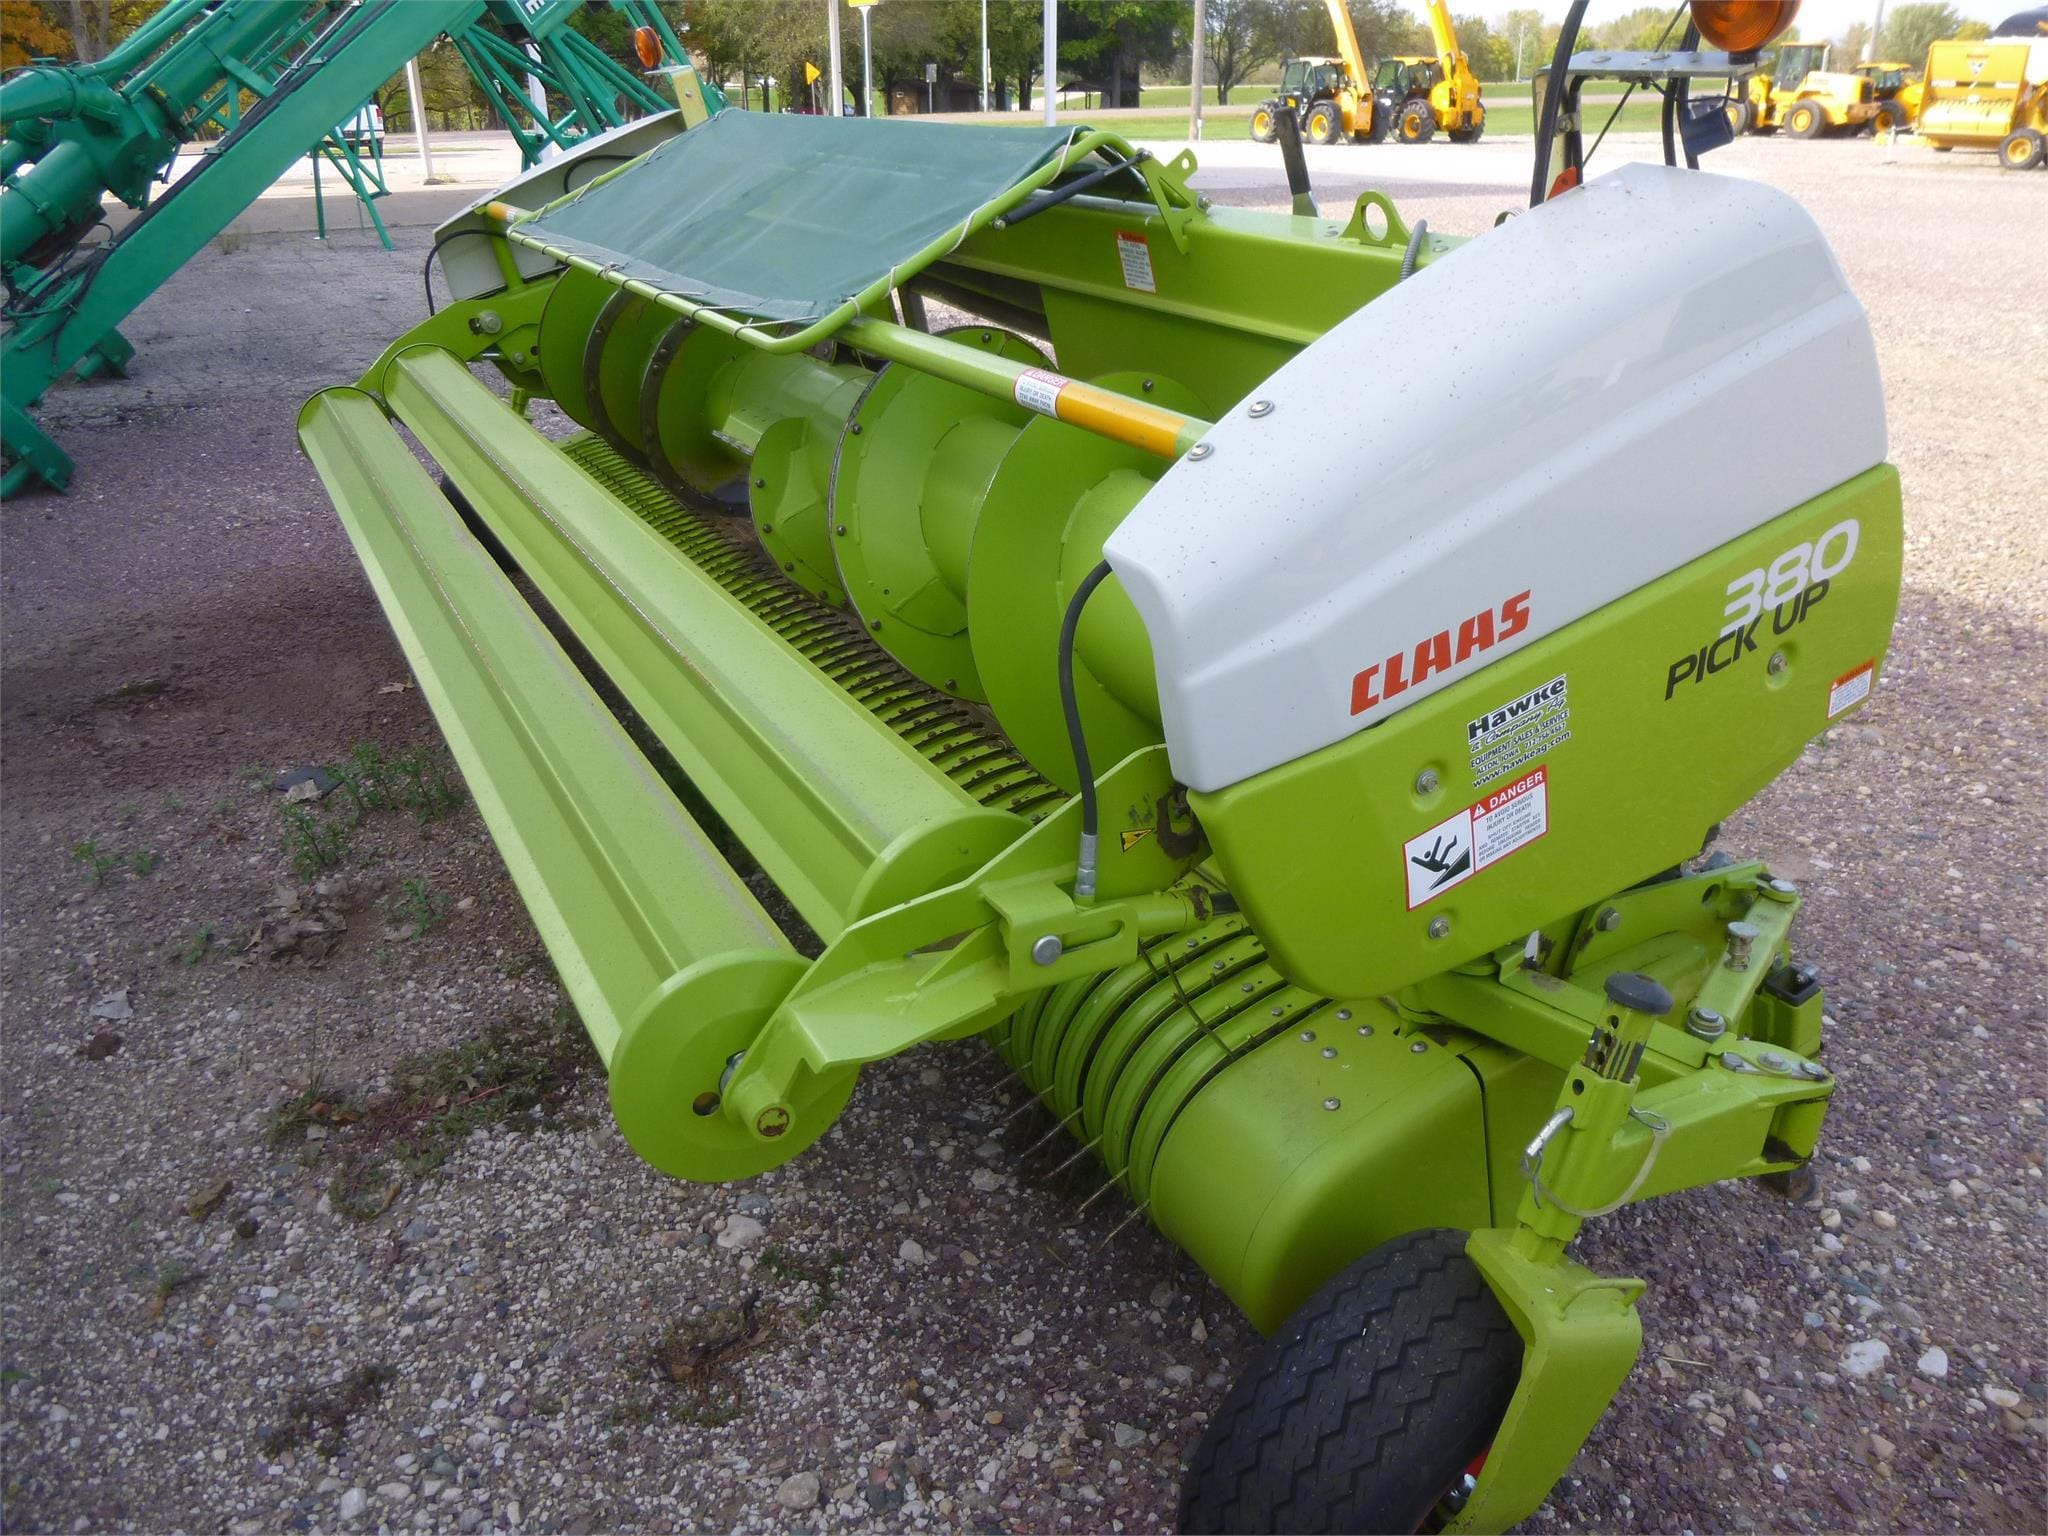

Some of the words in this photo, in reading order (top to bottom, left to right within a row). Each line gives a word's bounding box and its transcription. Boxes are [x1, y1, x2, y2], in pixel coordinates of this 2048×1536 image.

[1719, 518, 1859, 638] 380
[1350, 589, 1531, 717] CLAAS
[1664, 613, 1764, 702] PICK
[1772, 578, 1830, 636] UP
[1468, 678, 1566, 740] Hawke
[1485, 711, 1542, 744] Company
[1471, 740, 1511, 768] EQUIPMENT
[1513, 729, 1534, 746] SALES
[1541, 709, 1568, 729] SERVICE
[1473, 731, 1570, 788] www.hawkeag.com
[1501, 749, 1519, 762] IOWA
[1486, 815, 1493, 823] TO
[1494, 805, 1510, 818] AVOID
[1511, 793, 1533, 810] SERIOUS
[1487, 817, 1505, 831] INJURY
[1506, 811, 1514, 820] OR
[1515, 802, 1531, 815] DEATH
[1489, 771, 1543, 809] DANGER
